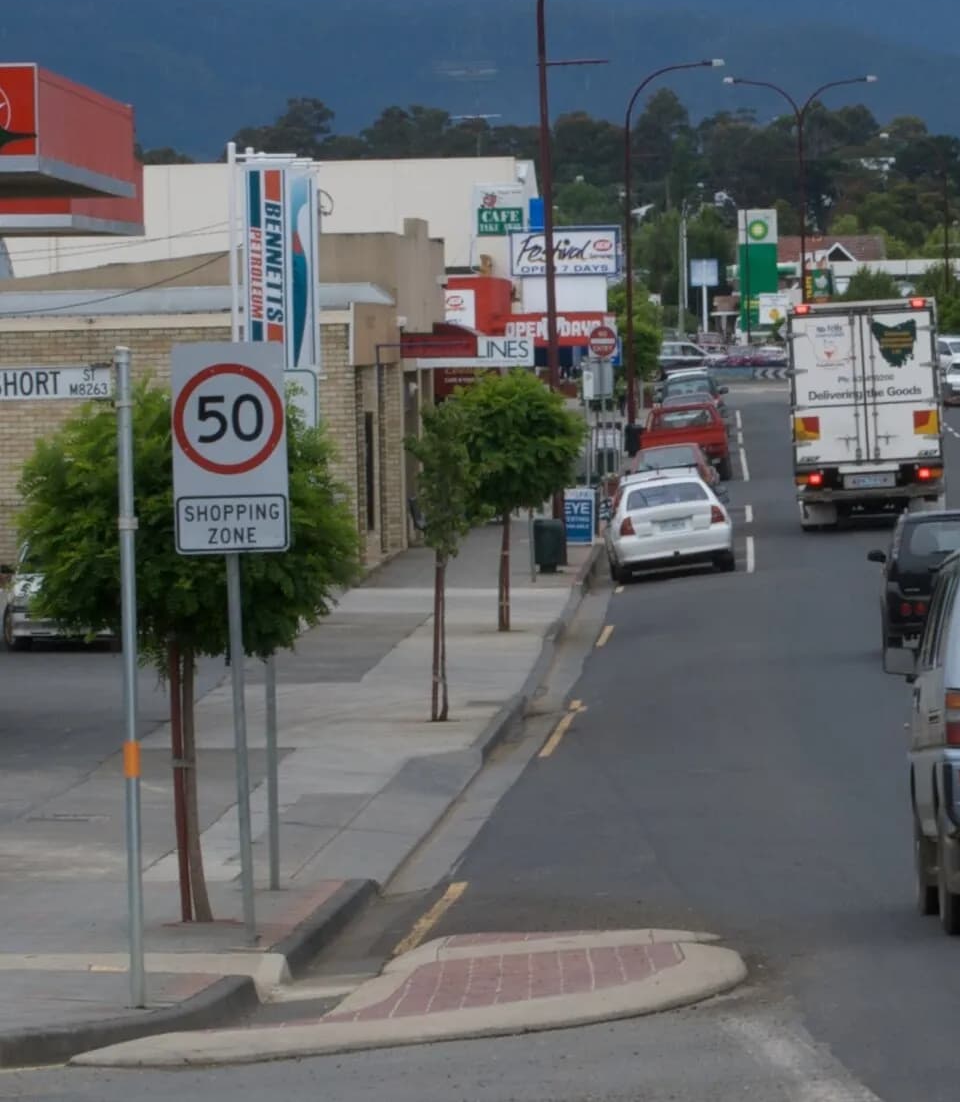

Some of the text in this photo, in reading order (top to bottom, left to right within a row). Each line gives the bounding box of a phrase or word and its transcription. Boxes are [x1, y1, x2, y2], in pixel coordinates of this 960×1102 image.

[482, 209, 520, 223] CAFE
[264, 201, 283, 323] BENNETTS
[562, 265, 569, 273] 7
[574, 264, 609, 273] DAYS
[250, 226, 263, 320] PETROLEUM
[0, 371, 60, 396] HORT
[83, 368, 96, 381] ST
[70, 383, 107, 395] M8263
[808, 385, 922, 402] Delivering the Goods
[197, 393, 264, 444] 50
[184, 503, 280, 523] SHOPPING
[208, 527, 257, 545] ZONE
